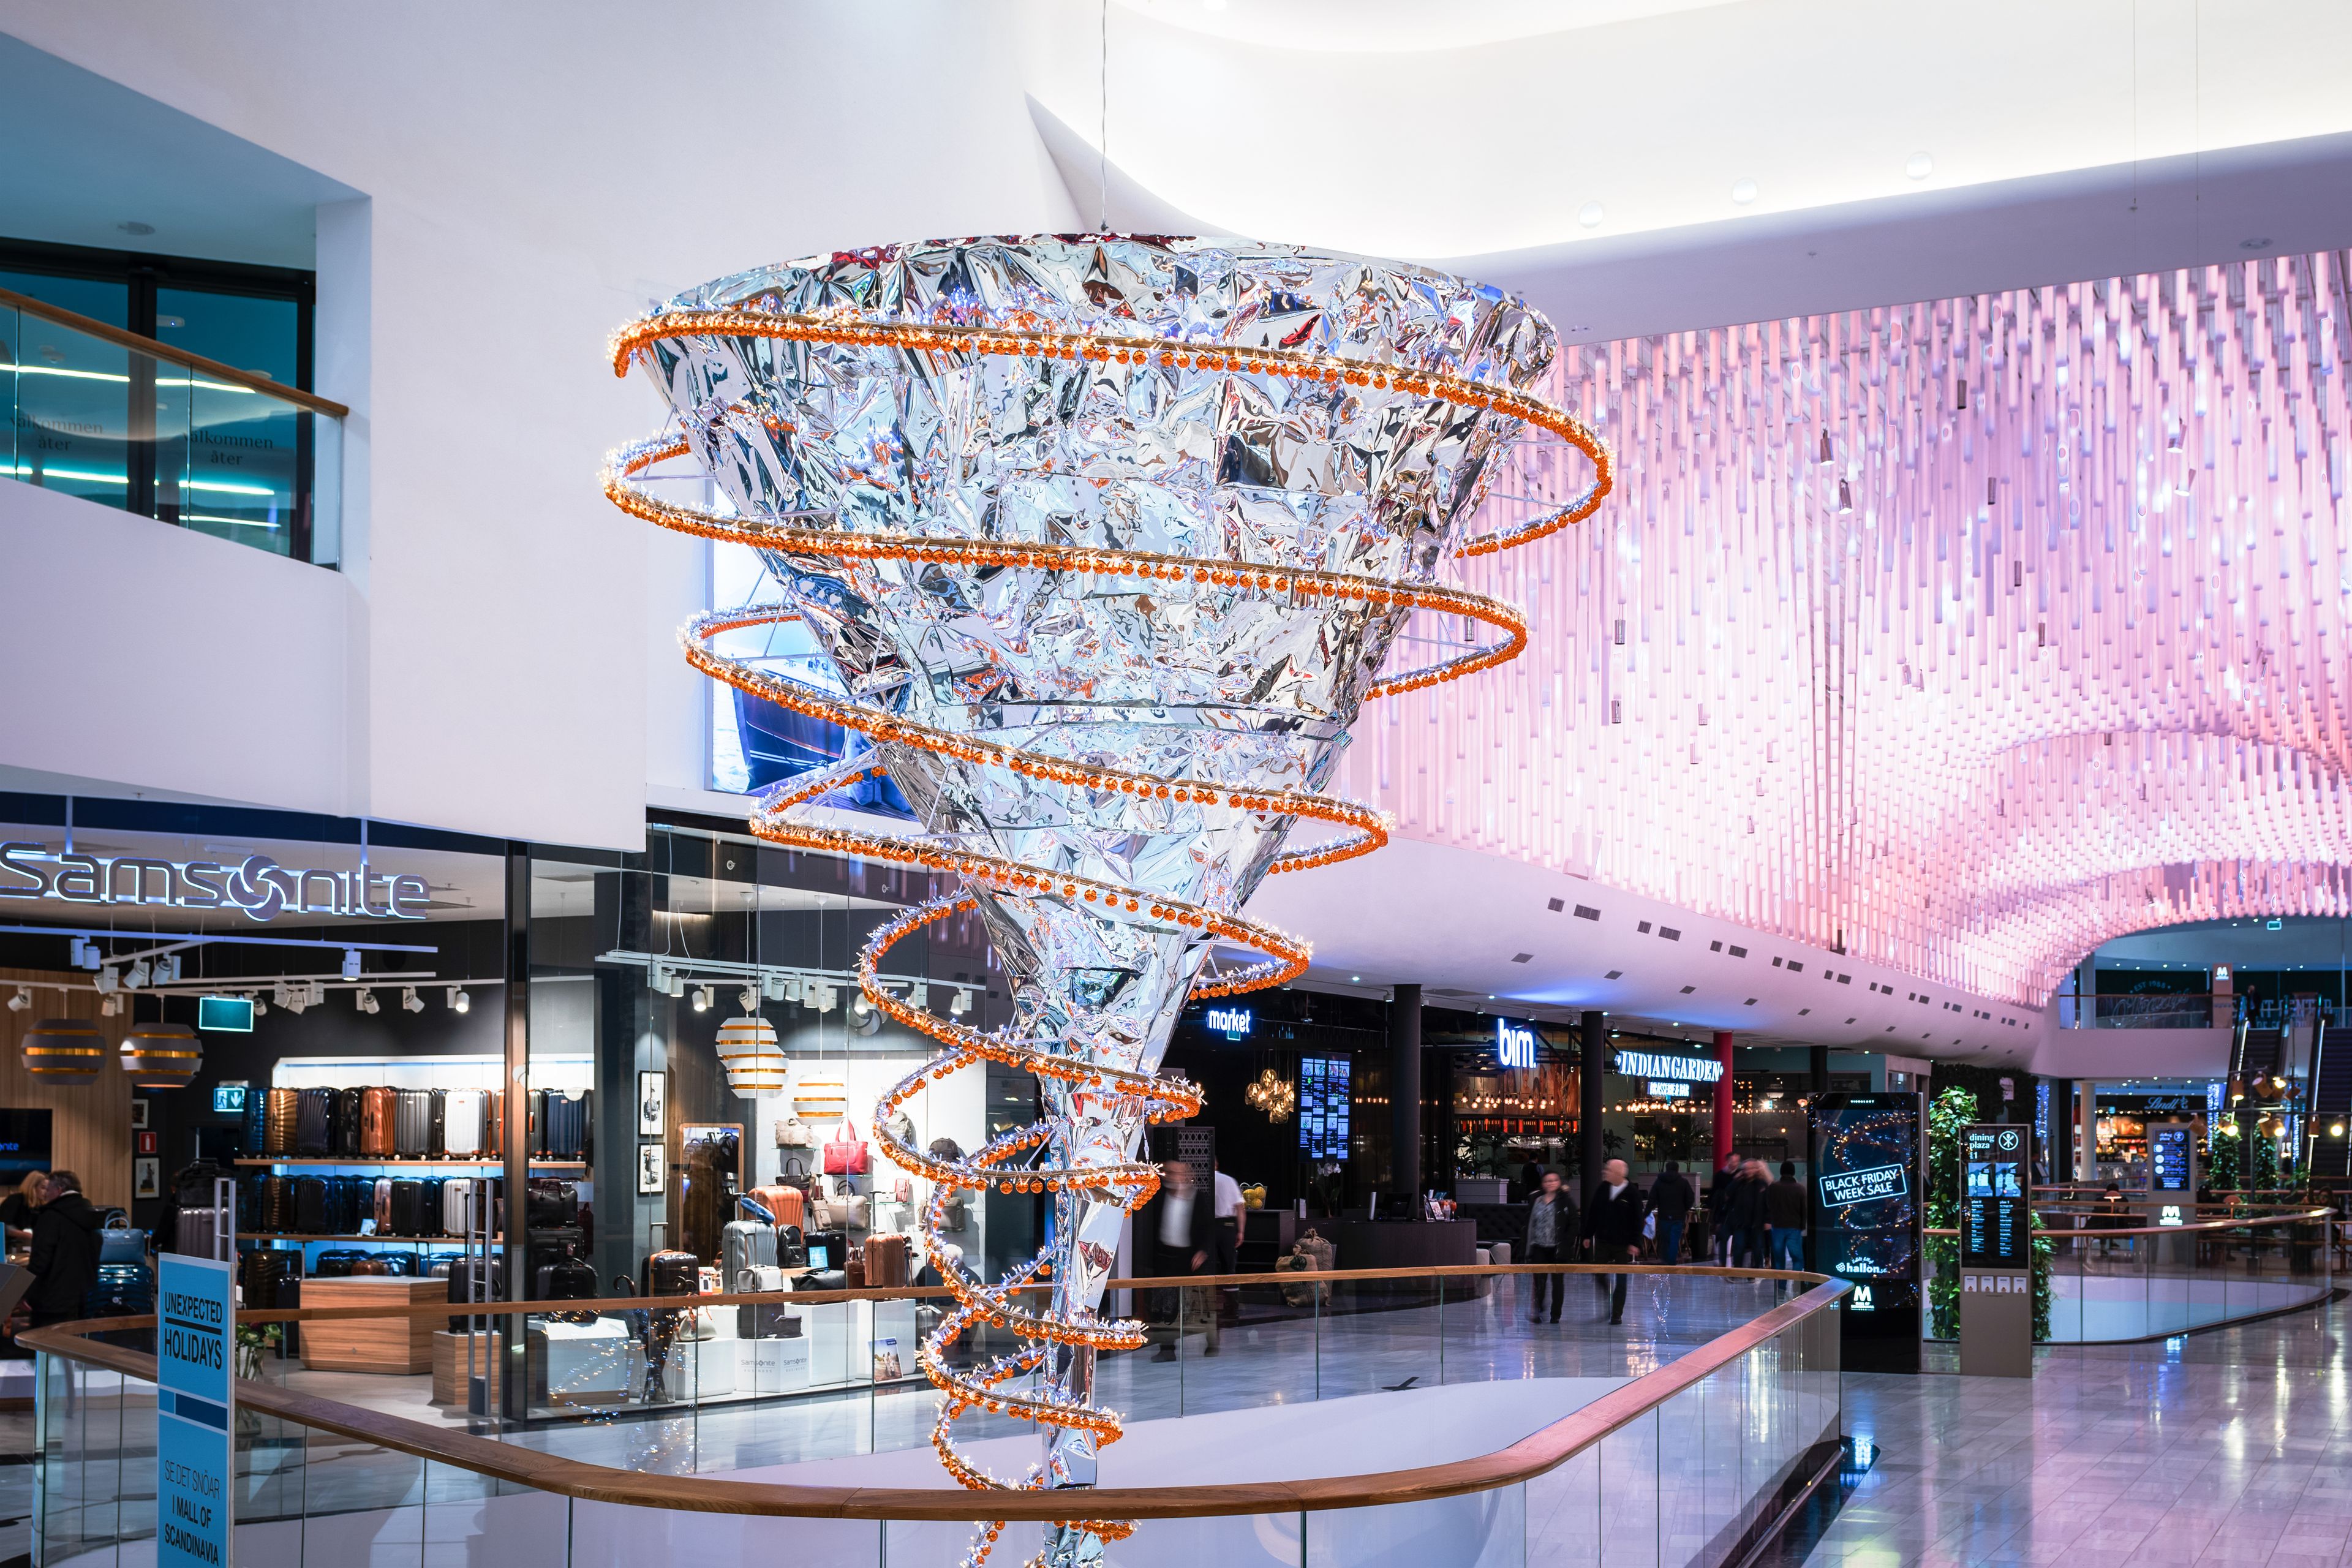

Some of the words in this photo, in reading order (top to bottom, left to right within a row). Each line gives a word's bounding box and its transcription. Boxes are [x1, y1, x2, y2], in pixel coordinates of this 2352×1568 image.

[1208, 1008, 1251, 1033] market
[1969, 1133, 1995, 1143] dining
[1969, 1142, 1990, 1151] plaza
[1825, 1176, 1860, 1191] BLACK
[1861, 1169, 1898, 1185] FRIDAY
[1834, 1186, 1866, 1201] WEEK
[1866, 1182, 1893, 1195] SALE
[1853, 1286, 1872, 1302] M
[165, 1291, 222, 1324] UNEXPECTED
[164, 1328, 222, 1370] HOLIDAYS
[783, 1357, 807, 1366] Samsonite
[165, 1460, 175, 1482] SE
[176, 1464, 191, 1488] DET
[192, 1469, 220, 1500] SNÖAR
[172, 1494, 175, 1514] I
[176, 1496, 198, 1524] MALL
[200, 1506, 211, 1529] OF
[165, 1523, 219, 1566] SCANDINAVIA
